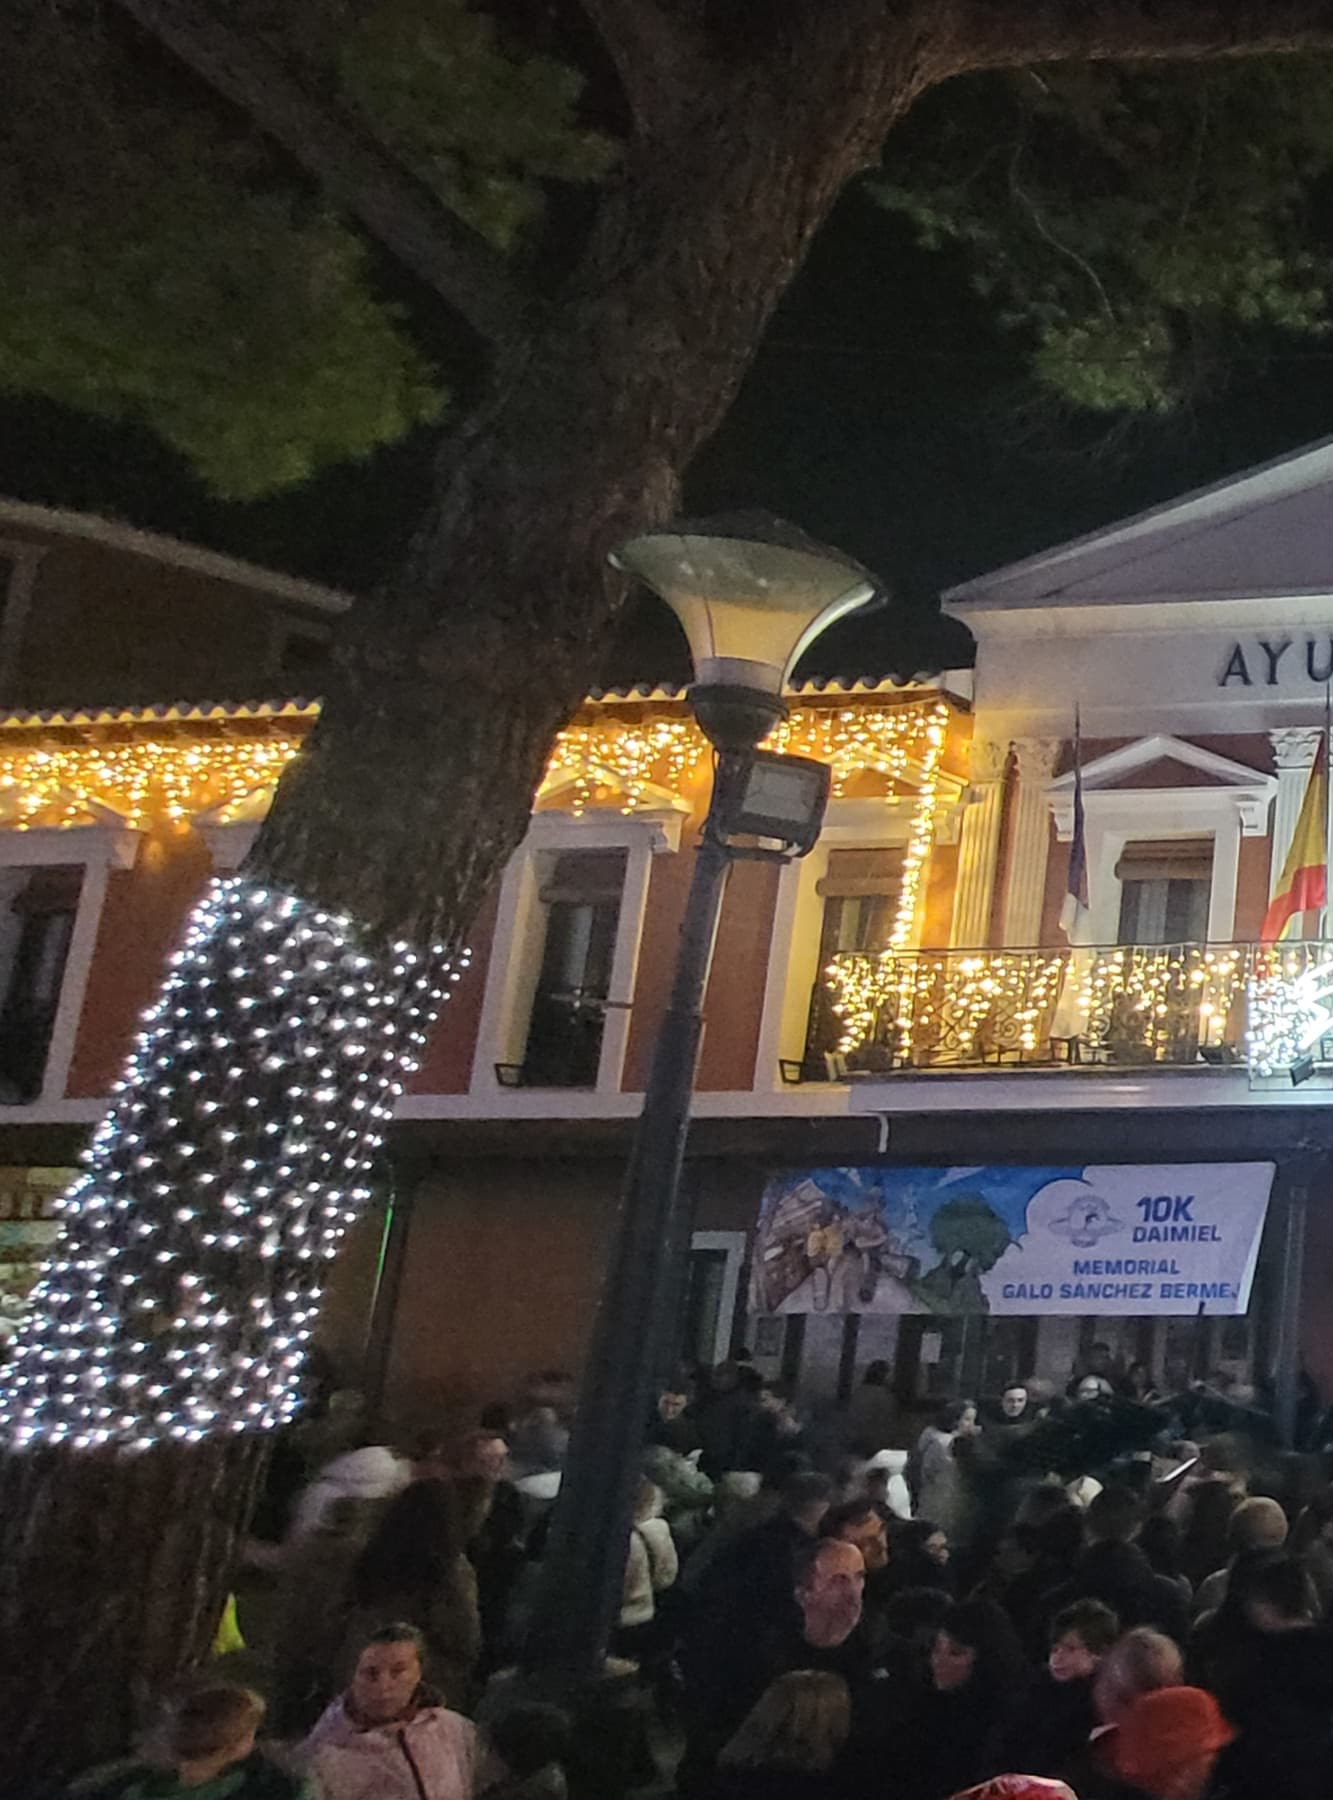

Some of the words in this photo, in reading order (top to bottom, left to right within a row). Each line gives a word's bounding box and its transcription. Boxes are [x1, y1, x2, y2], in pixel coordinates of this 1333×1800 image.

[1136, 1195, 1195, 1223] 10K
[1131, 1224, 1223, 1243] DAIMIEL
[1072, 1259, 1181, 1276] MEMORIAL
[1002, 1284, 1053, 1300] GALO
